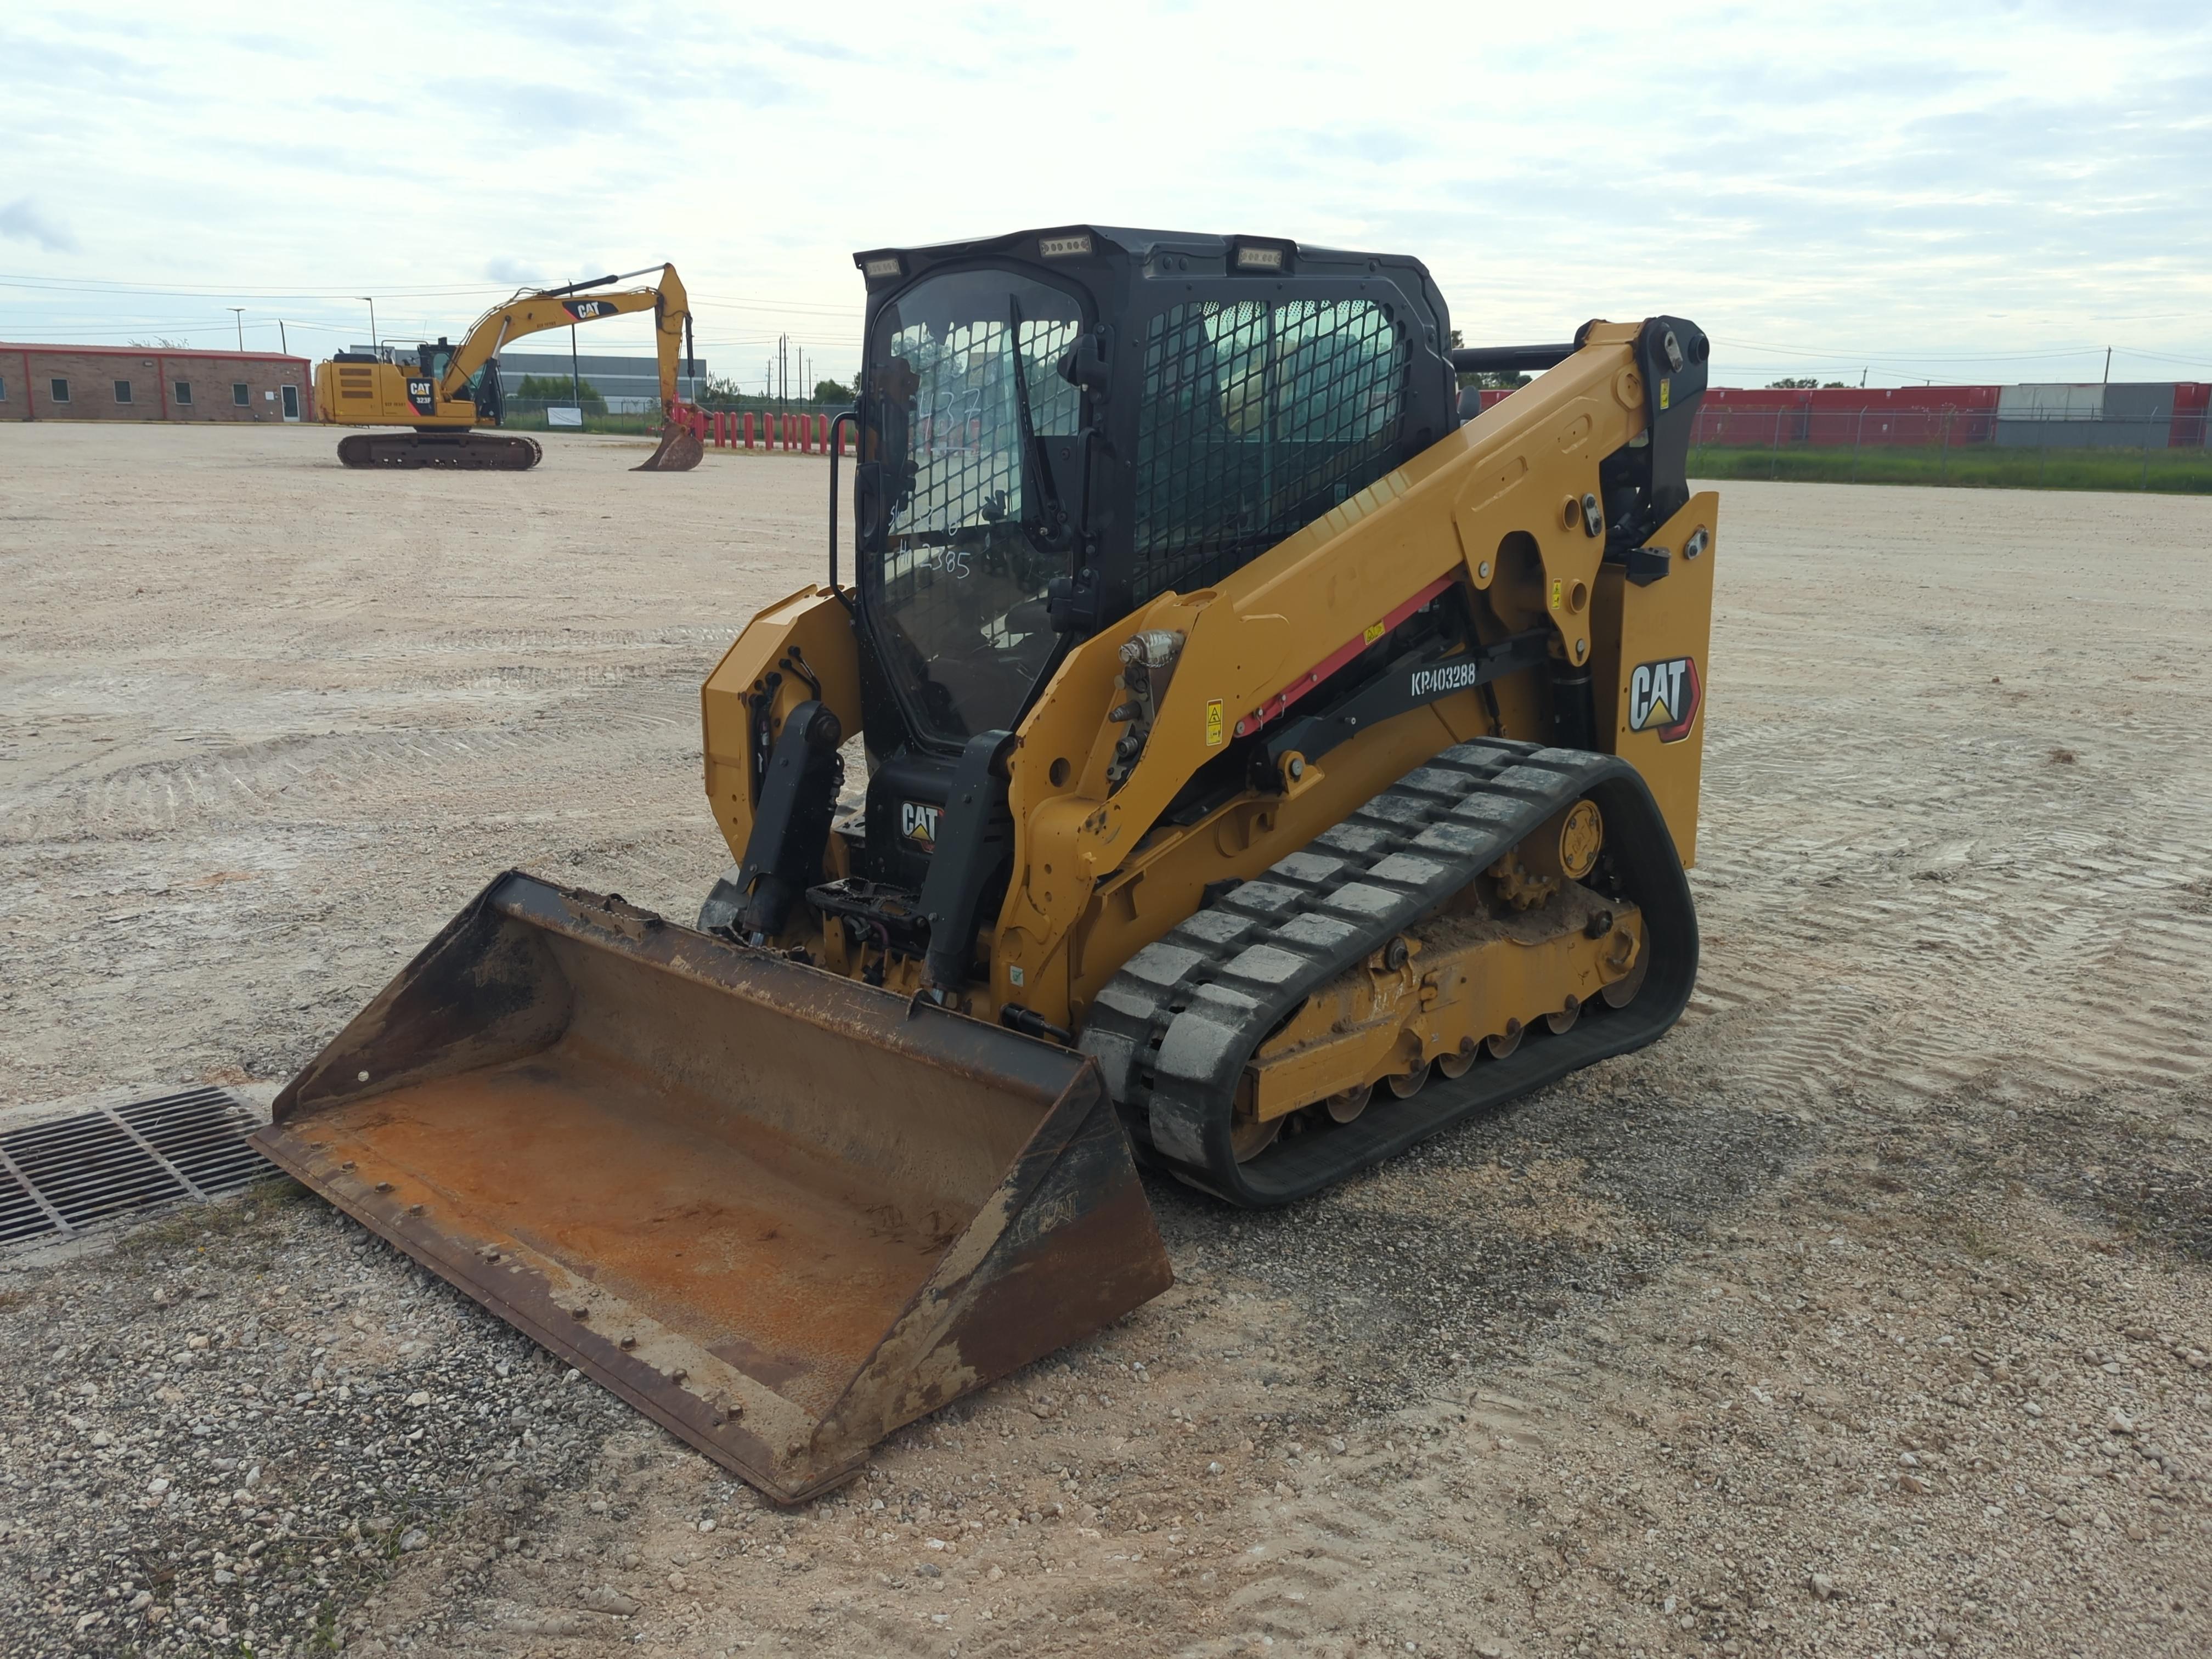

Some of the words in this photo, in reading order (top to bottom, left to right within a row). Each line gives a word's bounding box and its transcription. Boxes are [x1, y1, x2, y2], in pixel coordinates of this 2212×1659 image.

[578, 302, 600, 318] CAT
[410, 383, 430, 394] CAT
[919, 388, 981, 441] 437
[920, 543, 971, 579] 2385
[1412, 663, 1475, 696] KP403288
[1630, 660, 1686, 730] CAT
[902, 803, 938, 842] CAT
